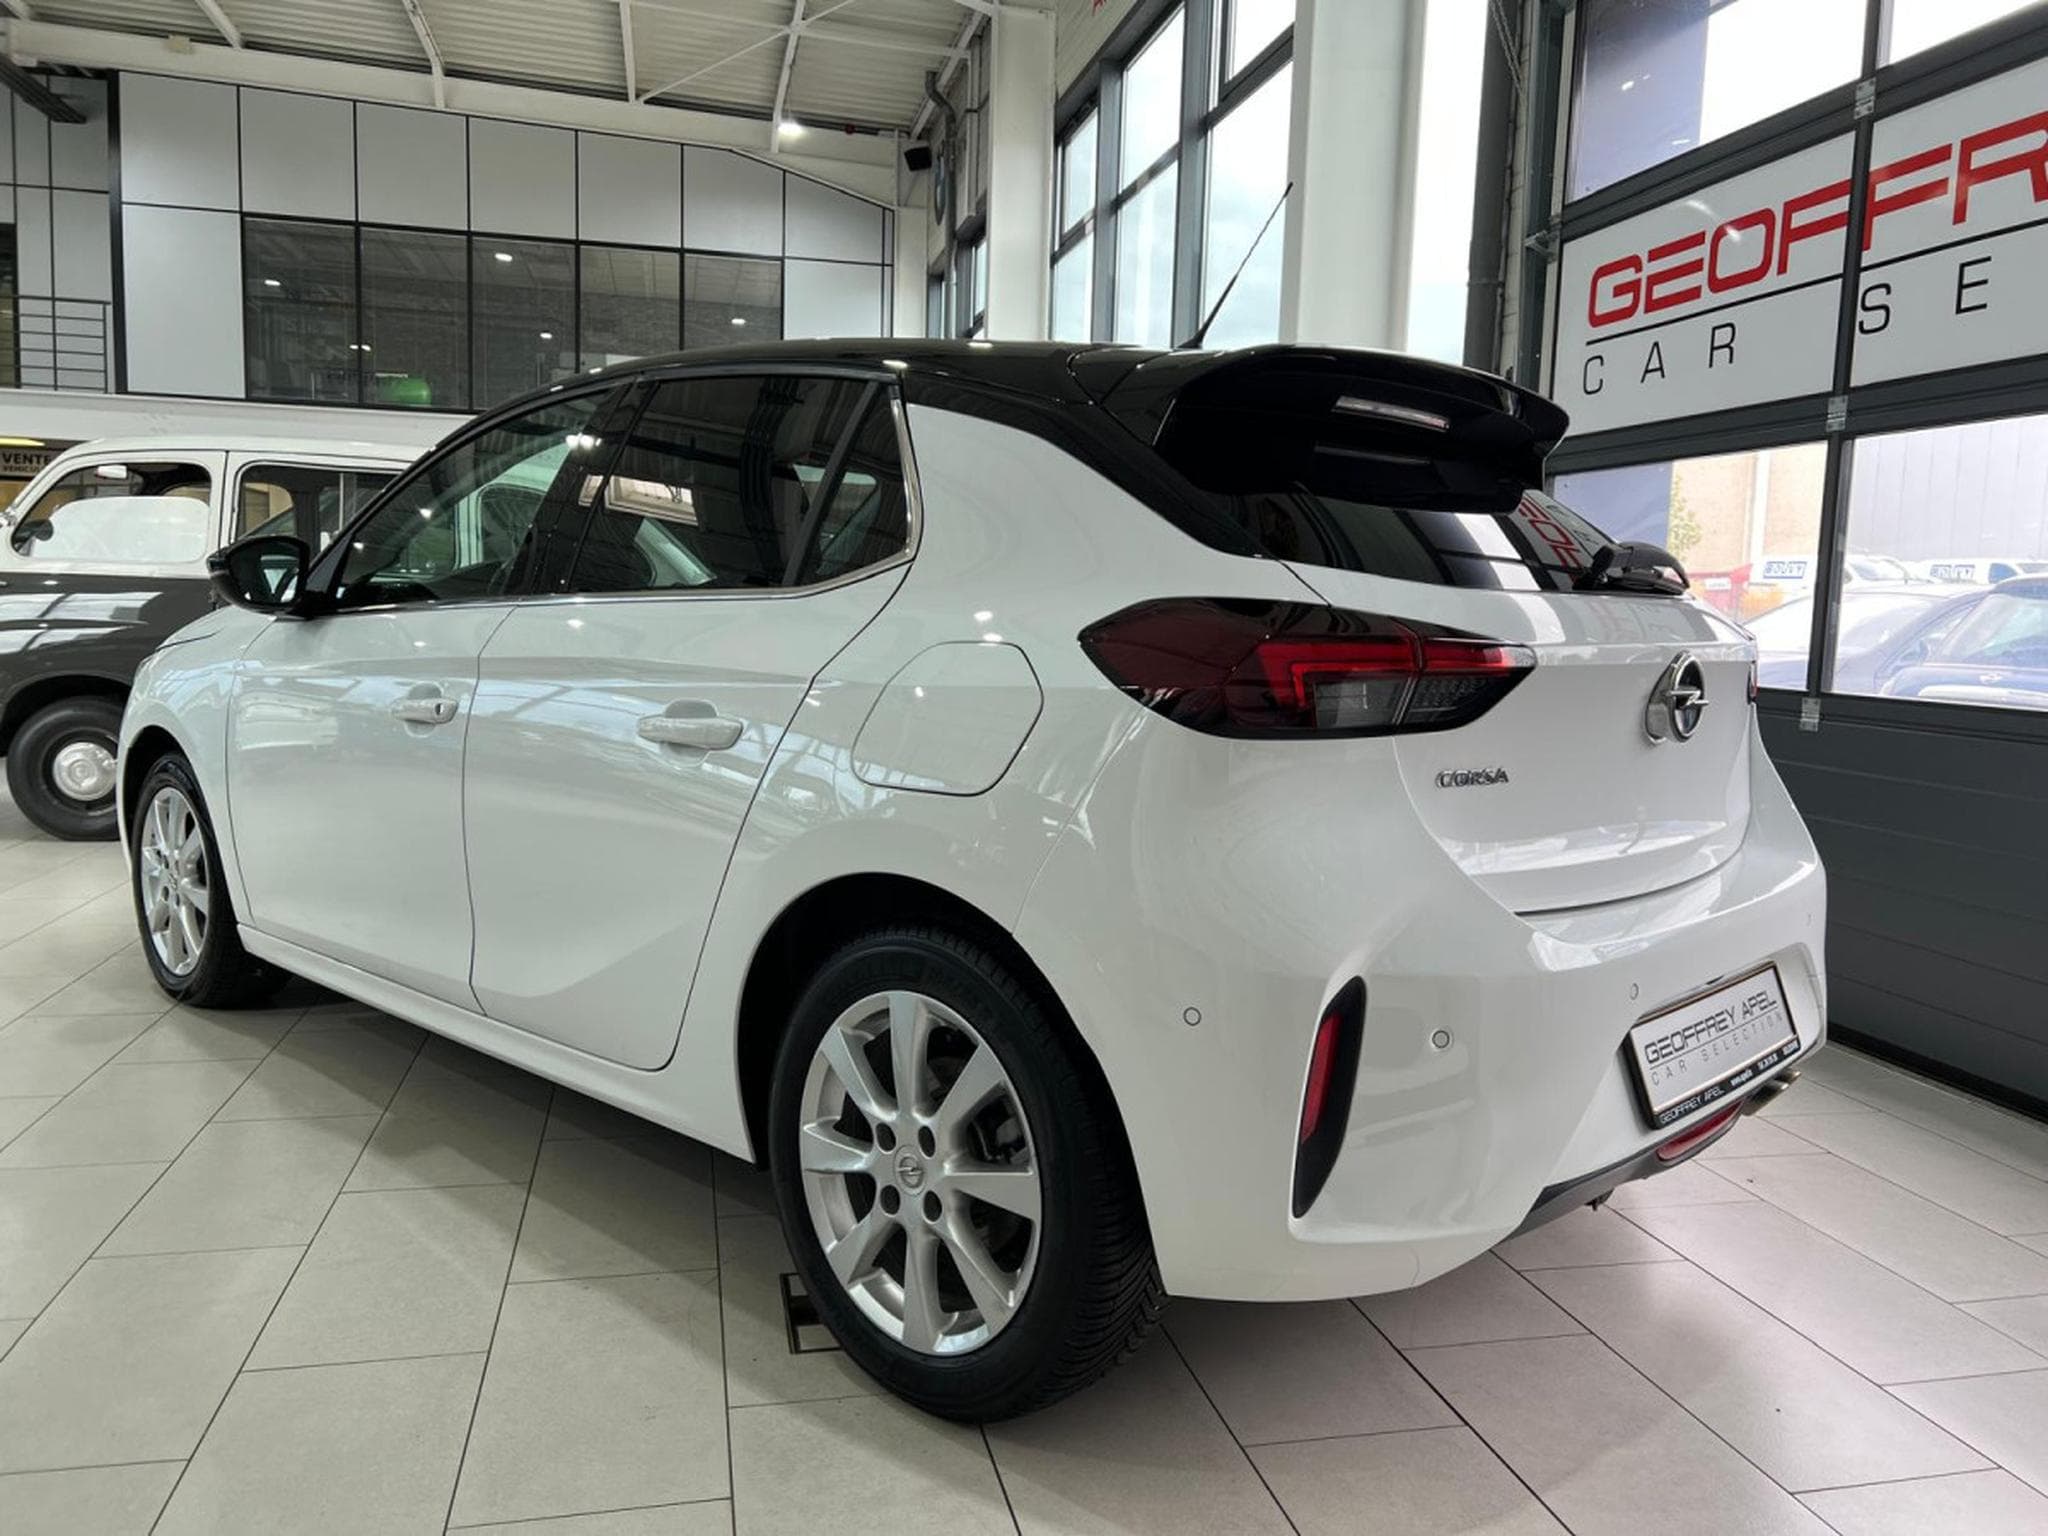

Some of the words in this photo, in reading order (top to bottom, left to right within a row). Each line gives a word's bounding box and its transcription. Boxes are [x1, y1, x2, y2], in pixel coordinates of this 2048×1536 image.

[1588, 110, 2048, 329] GEOFFR
[1583, 321, 1737, 396] CAR
[1858, 256, 1992, 335] SE
[2, 452, 50, 465] VENTE
[1435, 767, 1509, 788] CORSA
[1644, 1005, 1736, 1064] GEOFFREY
[1742, 990, 1778, 1019] APEL
[1651, 1059, 1688, 1086] CAR
[1700, 1010, 1784, 1062] SELECTION
